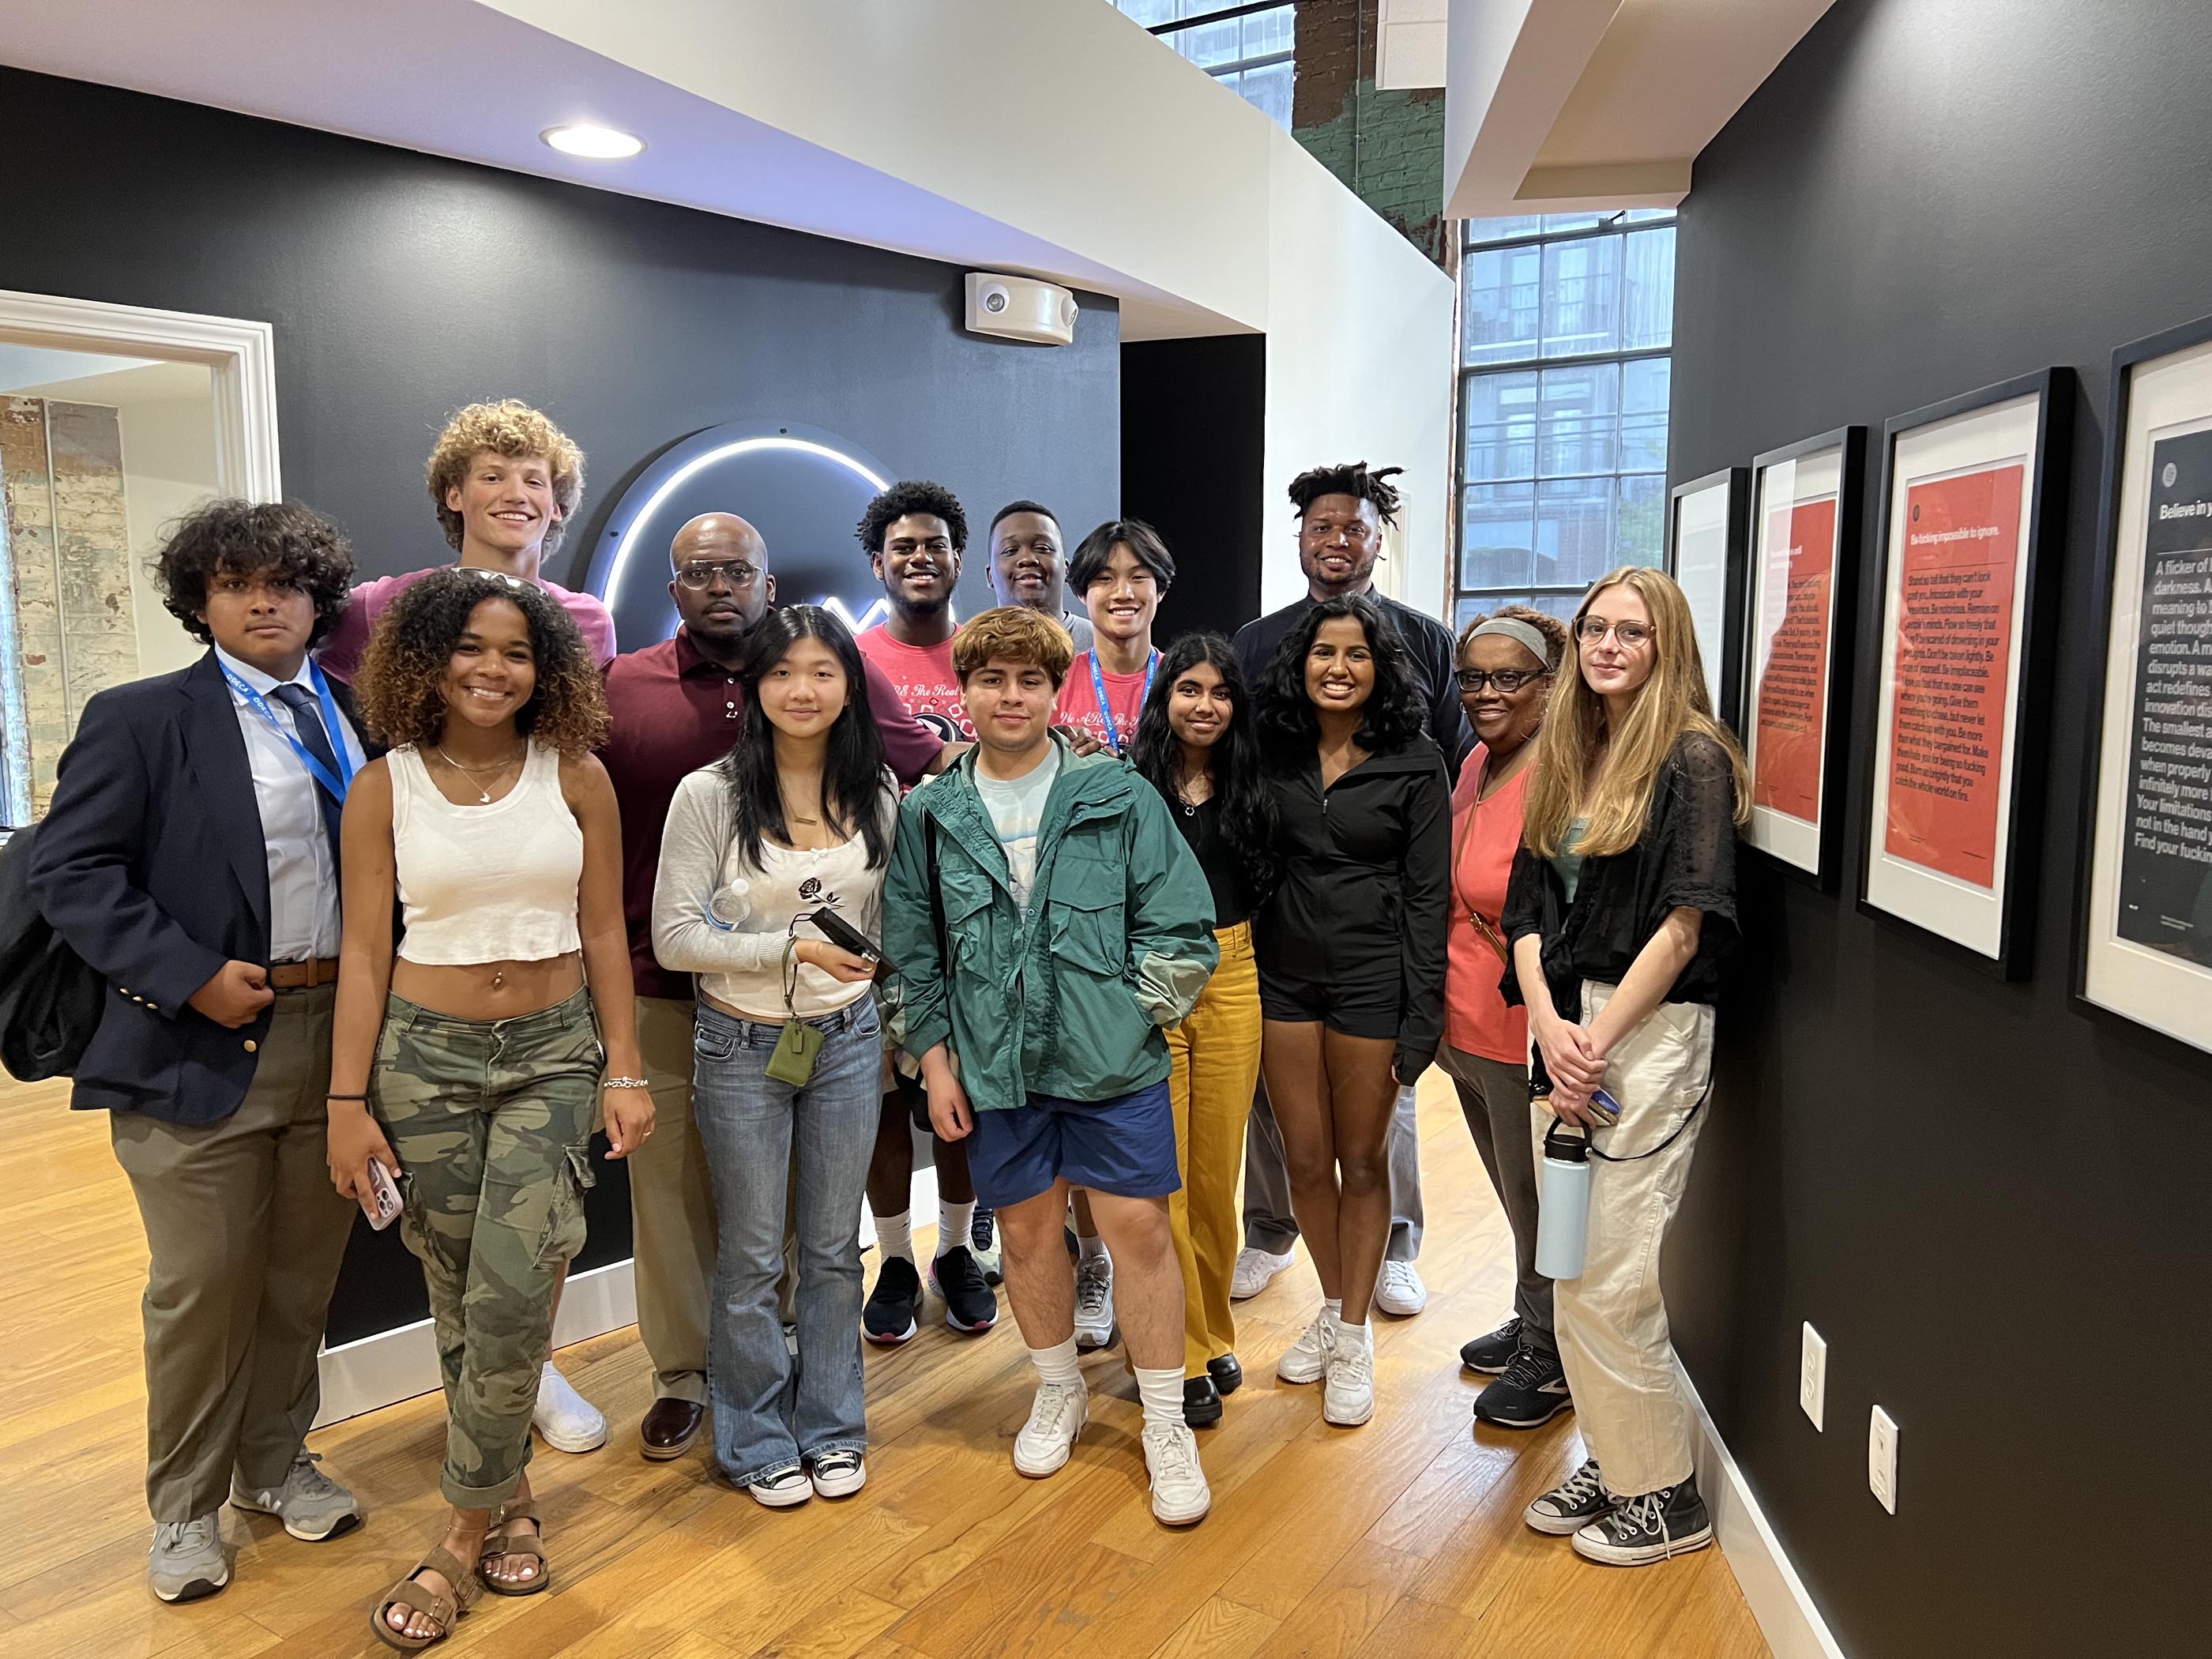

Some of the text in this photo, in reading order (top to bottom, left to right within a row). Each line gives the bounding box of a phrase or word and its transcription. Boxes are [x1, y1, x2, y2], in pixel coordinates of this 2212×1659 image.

[2160, 502, 2195, 520] Believe
[2196, 499, 2206, 515] in
[2155, 561, 2163, 576] A
[2165, 559, 2196, 575] flicker
[2197, 557, 2209, 574] of
[2154, 580, 2202, 595] darkness.
[2152, 599, 2195, 617] meaning
[2196, 600, 2207, 614] to
[2151, 620, 2176, 638] quiet
[2150, 640, 2191, 655] emotion.
[2192, 640, 2200, 655] A
[2148, 659, 2188, 678] disrupts
[2189, 664, 2195, 675] a
[911, 684, 931, 697] The
[932, 684, 960, 696] Real
[2146, 679, 2211, 697] act redefines
[2145, 698, 2195, 717] innovation
[2142, 717, 2161, 733] The
[2162, 720, 2204, 738] smallest
[2142, 736, 2187, 756] becomes
[2140, 757, 2211, 783] when properly
[2139, 775, 2209, 800] infinitely more
[2136, 793, 2212, 822] Your limitations
[2135, 816, 2152, 830] not
[2153, 816, 2162, 832] in
[2164, 818, 2180, 836] the
[2180, 821, 2208, 841] hand
[2135, 832, 2157, 850] Find
[2156, 840, 2180, 855] your
